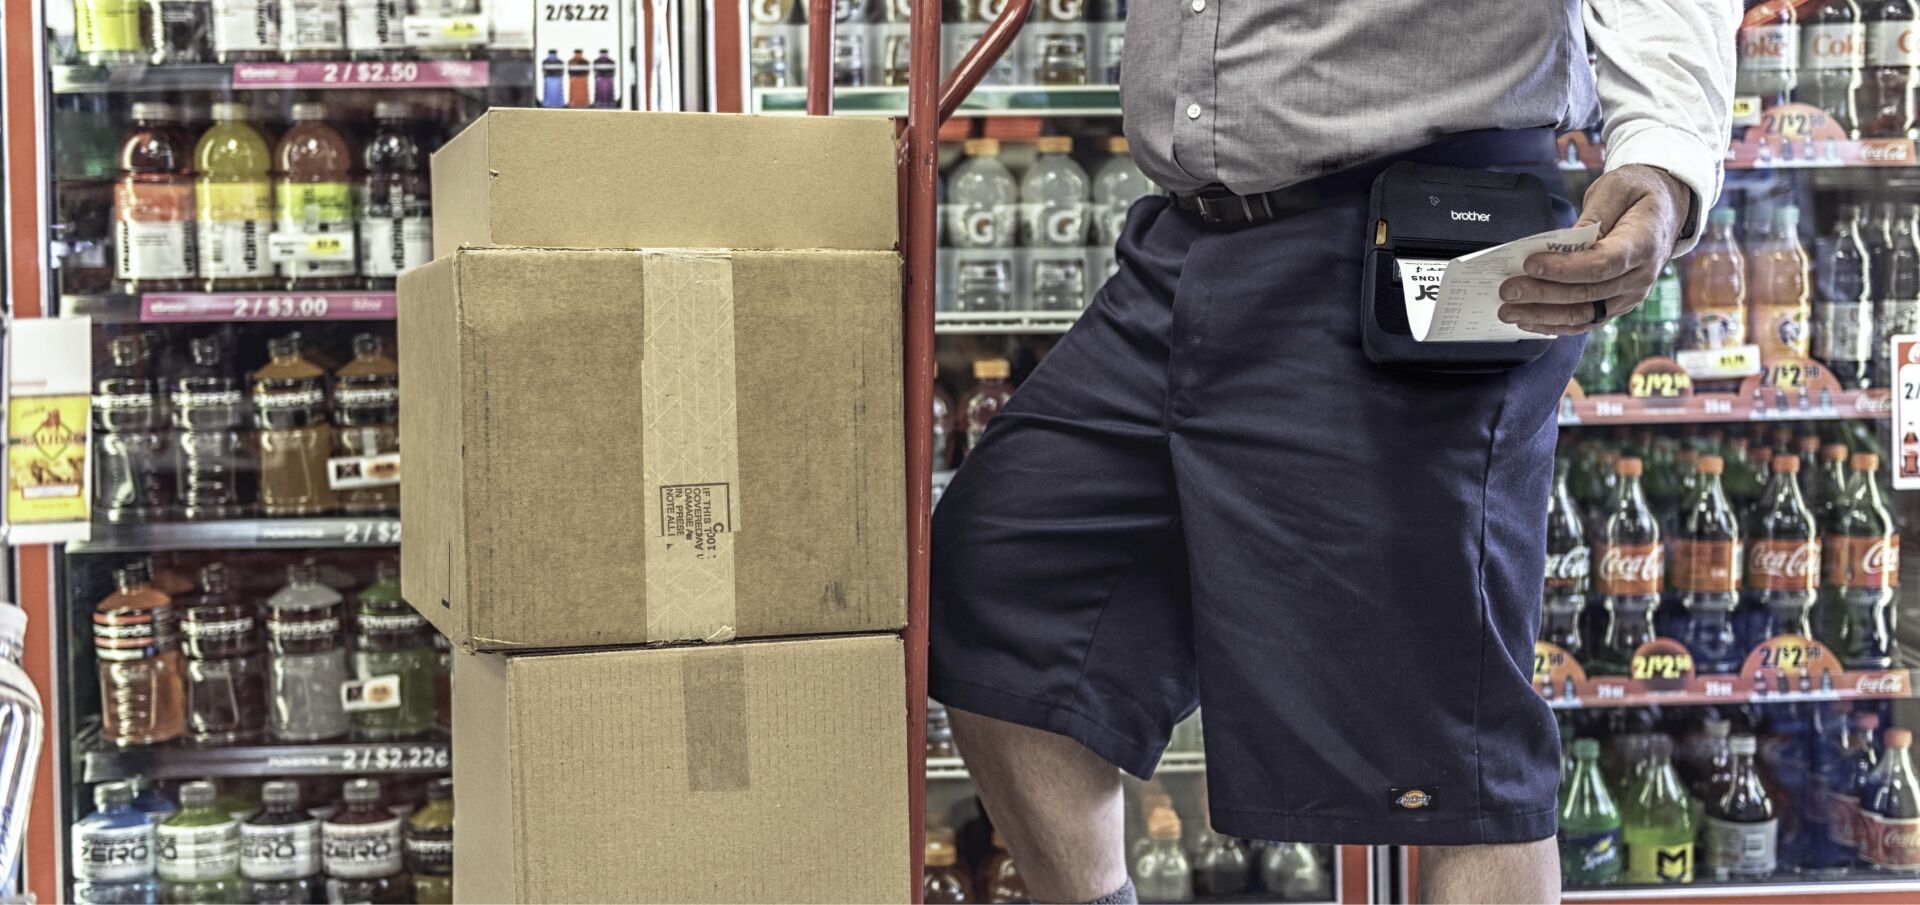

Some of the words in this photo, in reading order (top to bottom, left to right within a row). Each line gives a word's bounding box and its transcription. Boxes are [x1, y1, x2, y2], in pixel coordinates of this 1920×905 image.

[545, 4, 609, 21] 2/$2.22
[1745, 34, 1784, 58] oke
[358, 62, 418, 82] $2.50
[1450, 209, 1491, 222] brother
[969, 212, 995, 244] G
[1048, 211, 1077, 243] G
[267, 296, 328, 318] $3.00
[667, 489, 675, 514] NOTE
[676, 488, 683, 497] IN
[684, 487, 694, 527] DAMAGE
[704, 501, 712, 524] THIS
[343, 521, 358, 543] 2
[342, 748, 357, 770] 2
